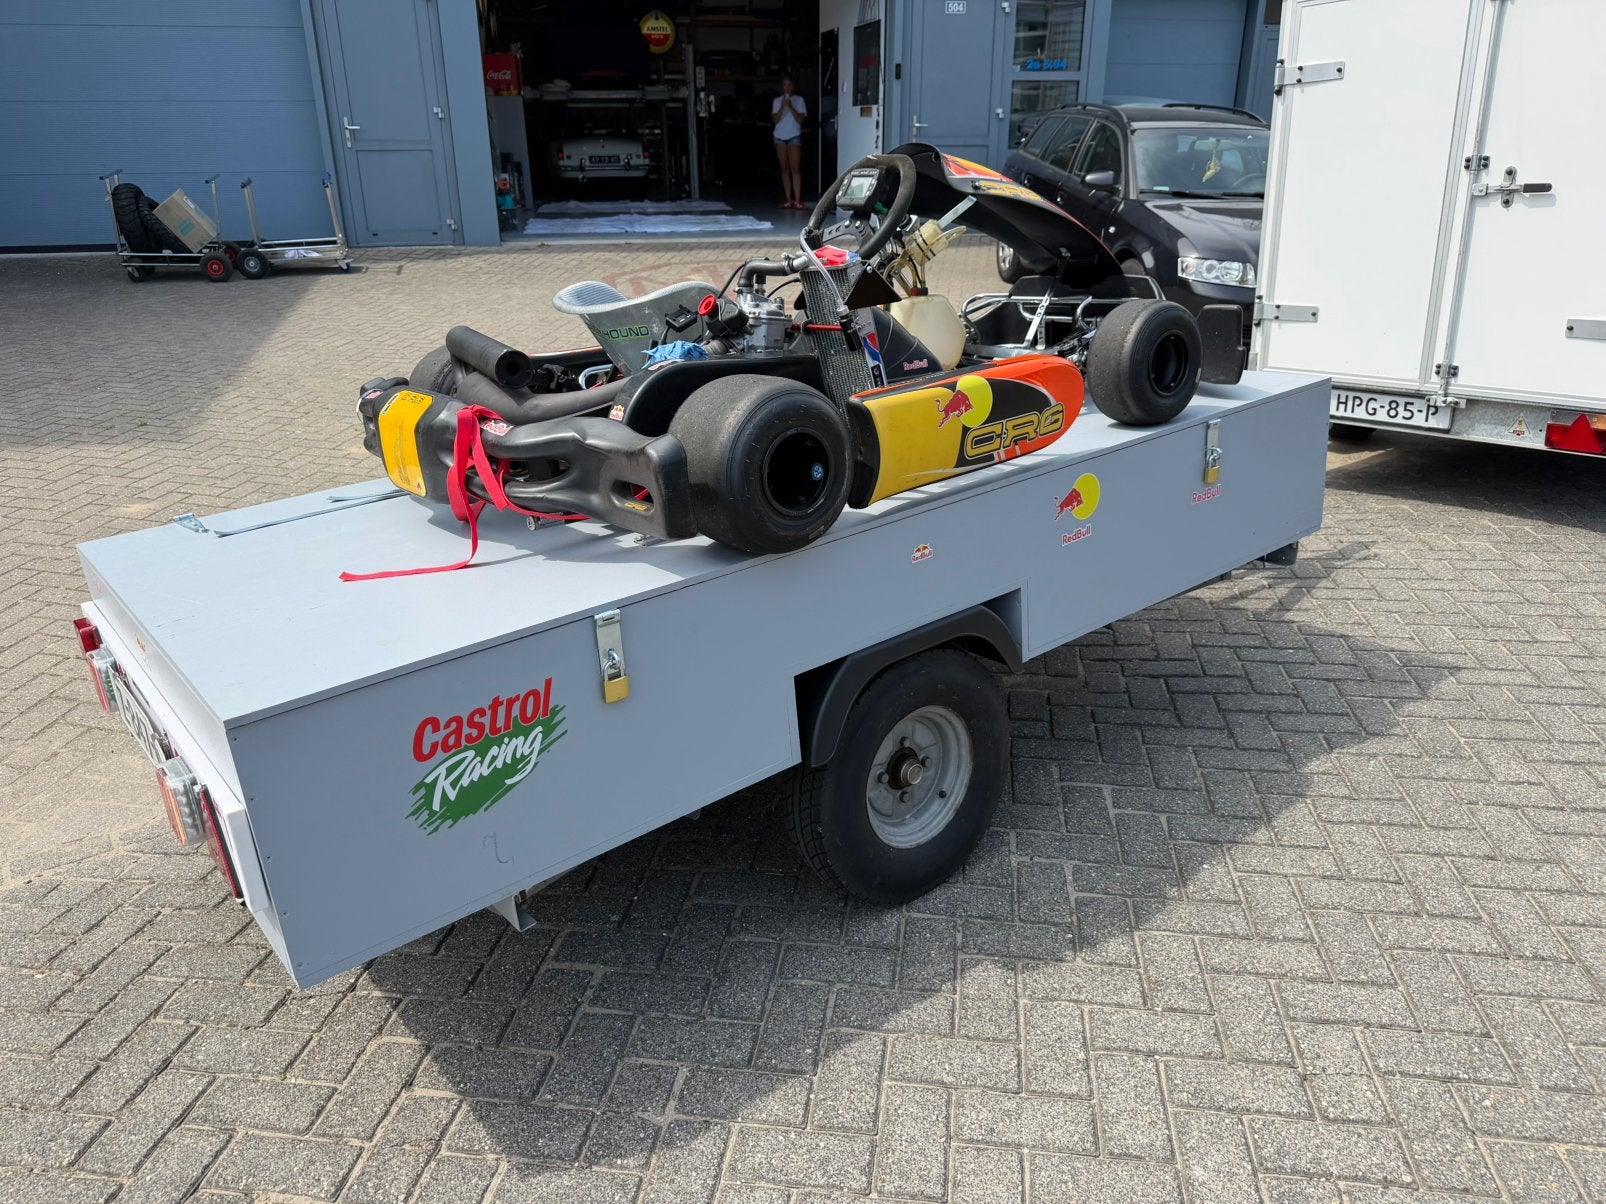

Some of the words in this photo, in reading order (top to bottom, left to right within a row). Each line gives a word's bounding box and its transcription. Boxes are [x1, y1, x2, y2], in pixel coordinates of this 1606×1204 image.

[948, 3, 964, 12] 504
[1044, 58, 1067, 69] 5.04
[903, 359, 929, 371] RedBull
[1336, 393, 1439, 423] HPG-85-P
[964, 402, 1066, 460] CRG
[1192, 484, 1222, 505] RedBull
[1062, 524, 1092, 546] RedBull
[911, 550, 934, 563] RedBull
[413, 677, 552, 763] Castrol
[424, 725, 544, 812] Racing
